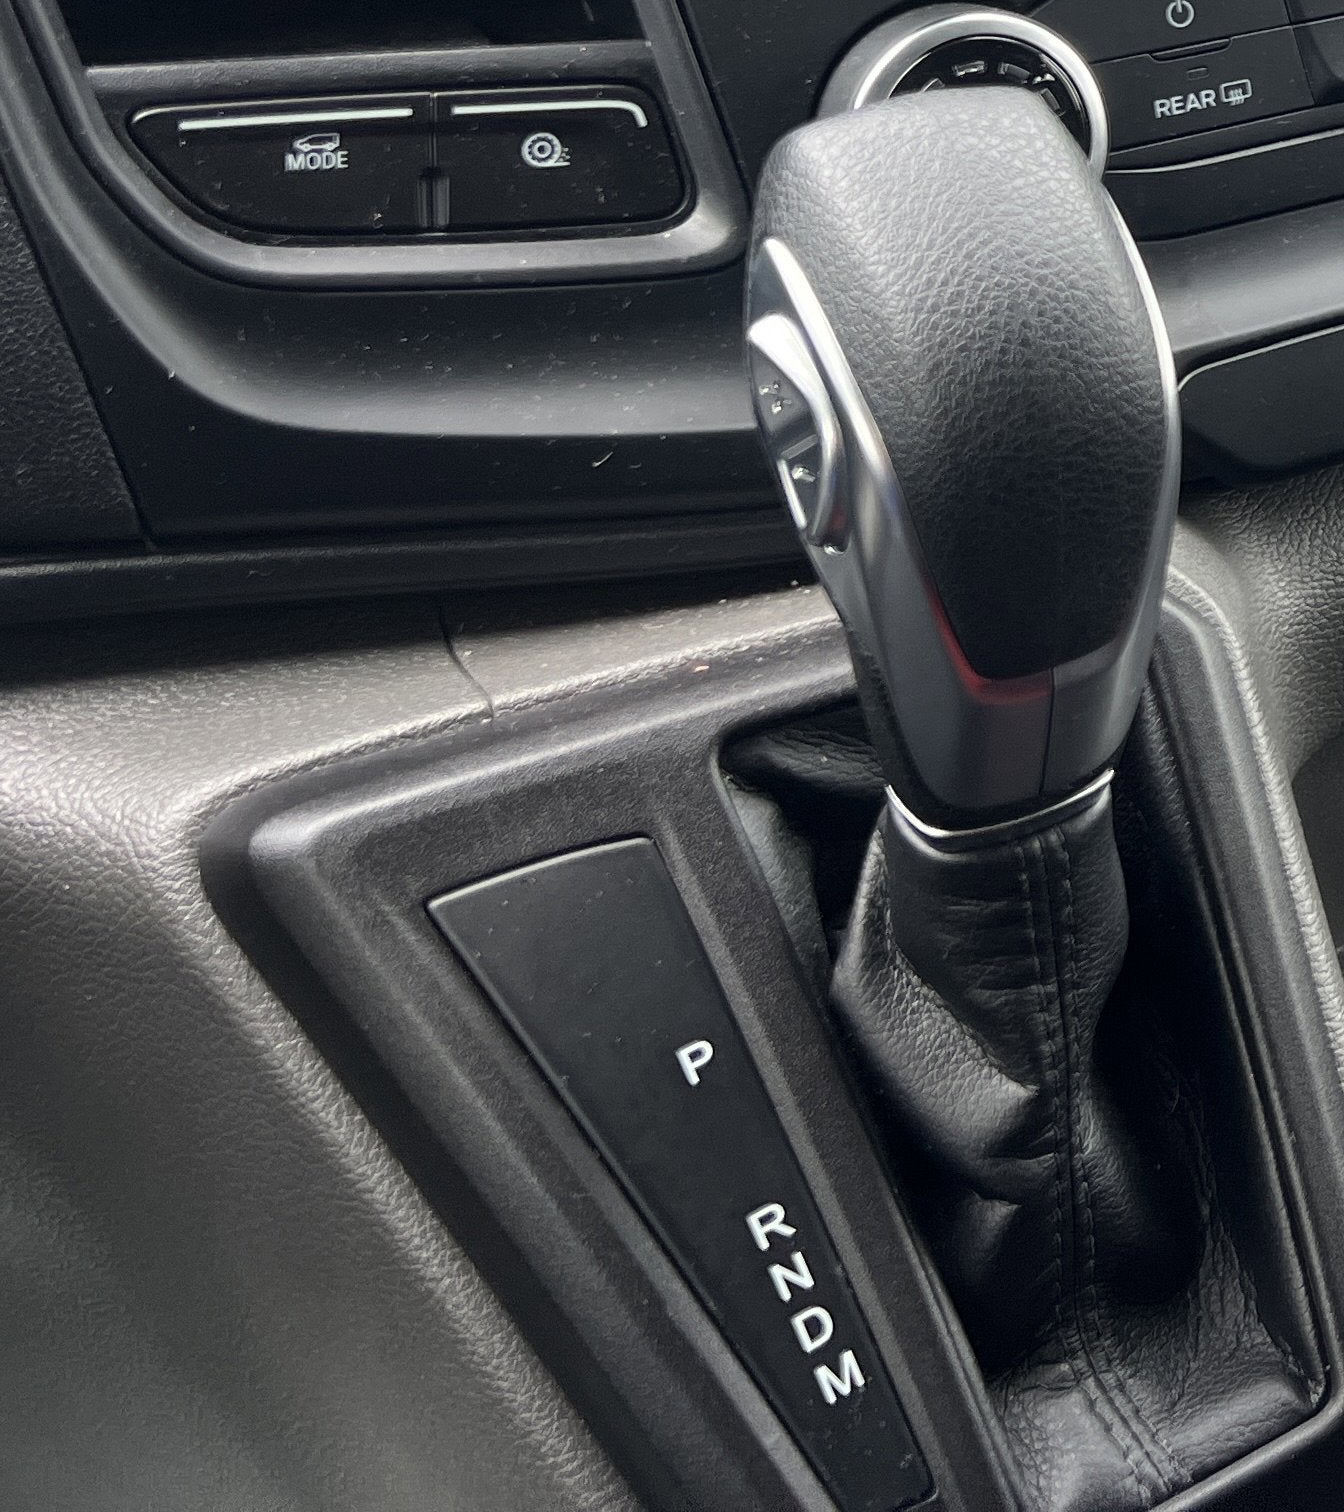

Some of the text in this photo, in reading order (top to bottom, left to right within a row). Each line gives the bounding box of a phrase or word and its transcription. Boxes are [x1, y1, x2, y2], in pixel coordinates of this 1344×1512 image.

[1153, 89, 1217, 119] REAR
[284, 149, 349, 171] MODE
[674, 1040, 715, 1087] P
[744, 1201, 798, 1253] R
[767, 1251, 816, 1304] N
[790, 1305, 836, 1356] D
[813, 1350, 867, 1406] M
